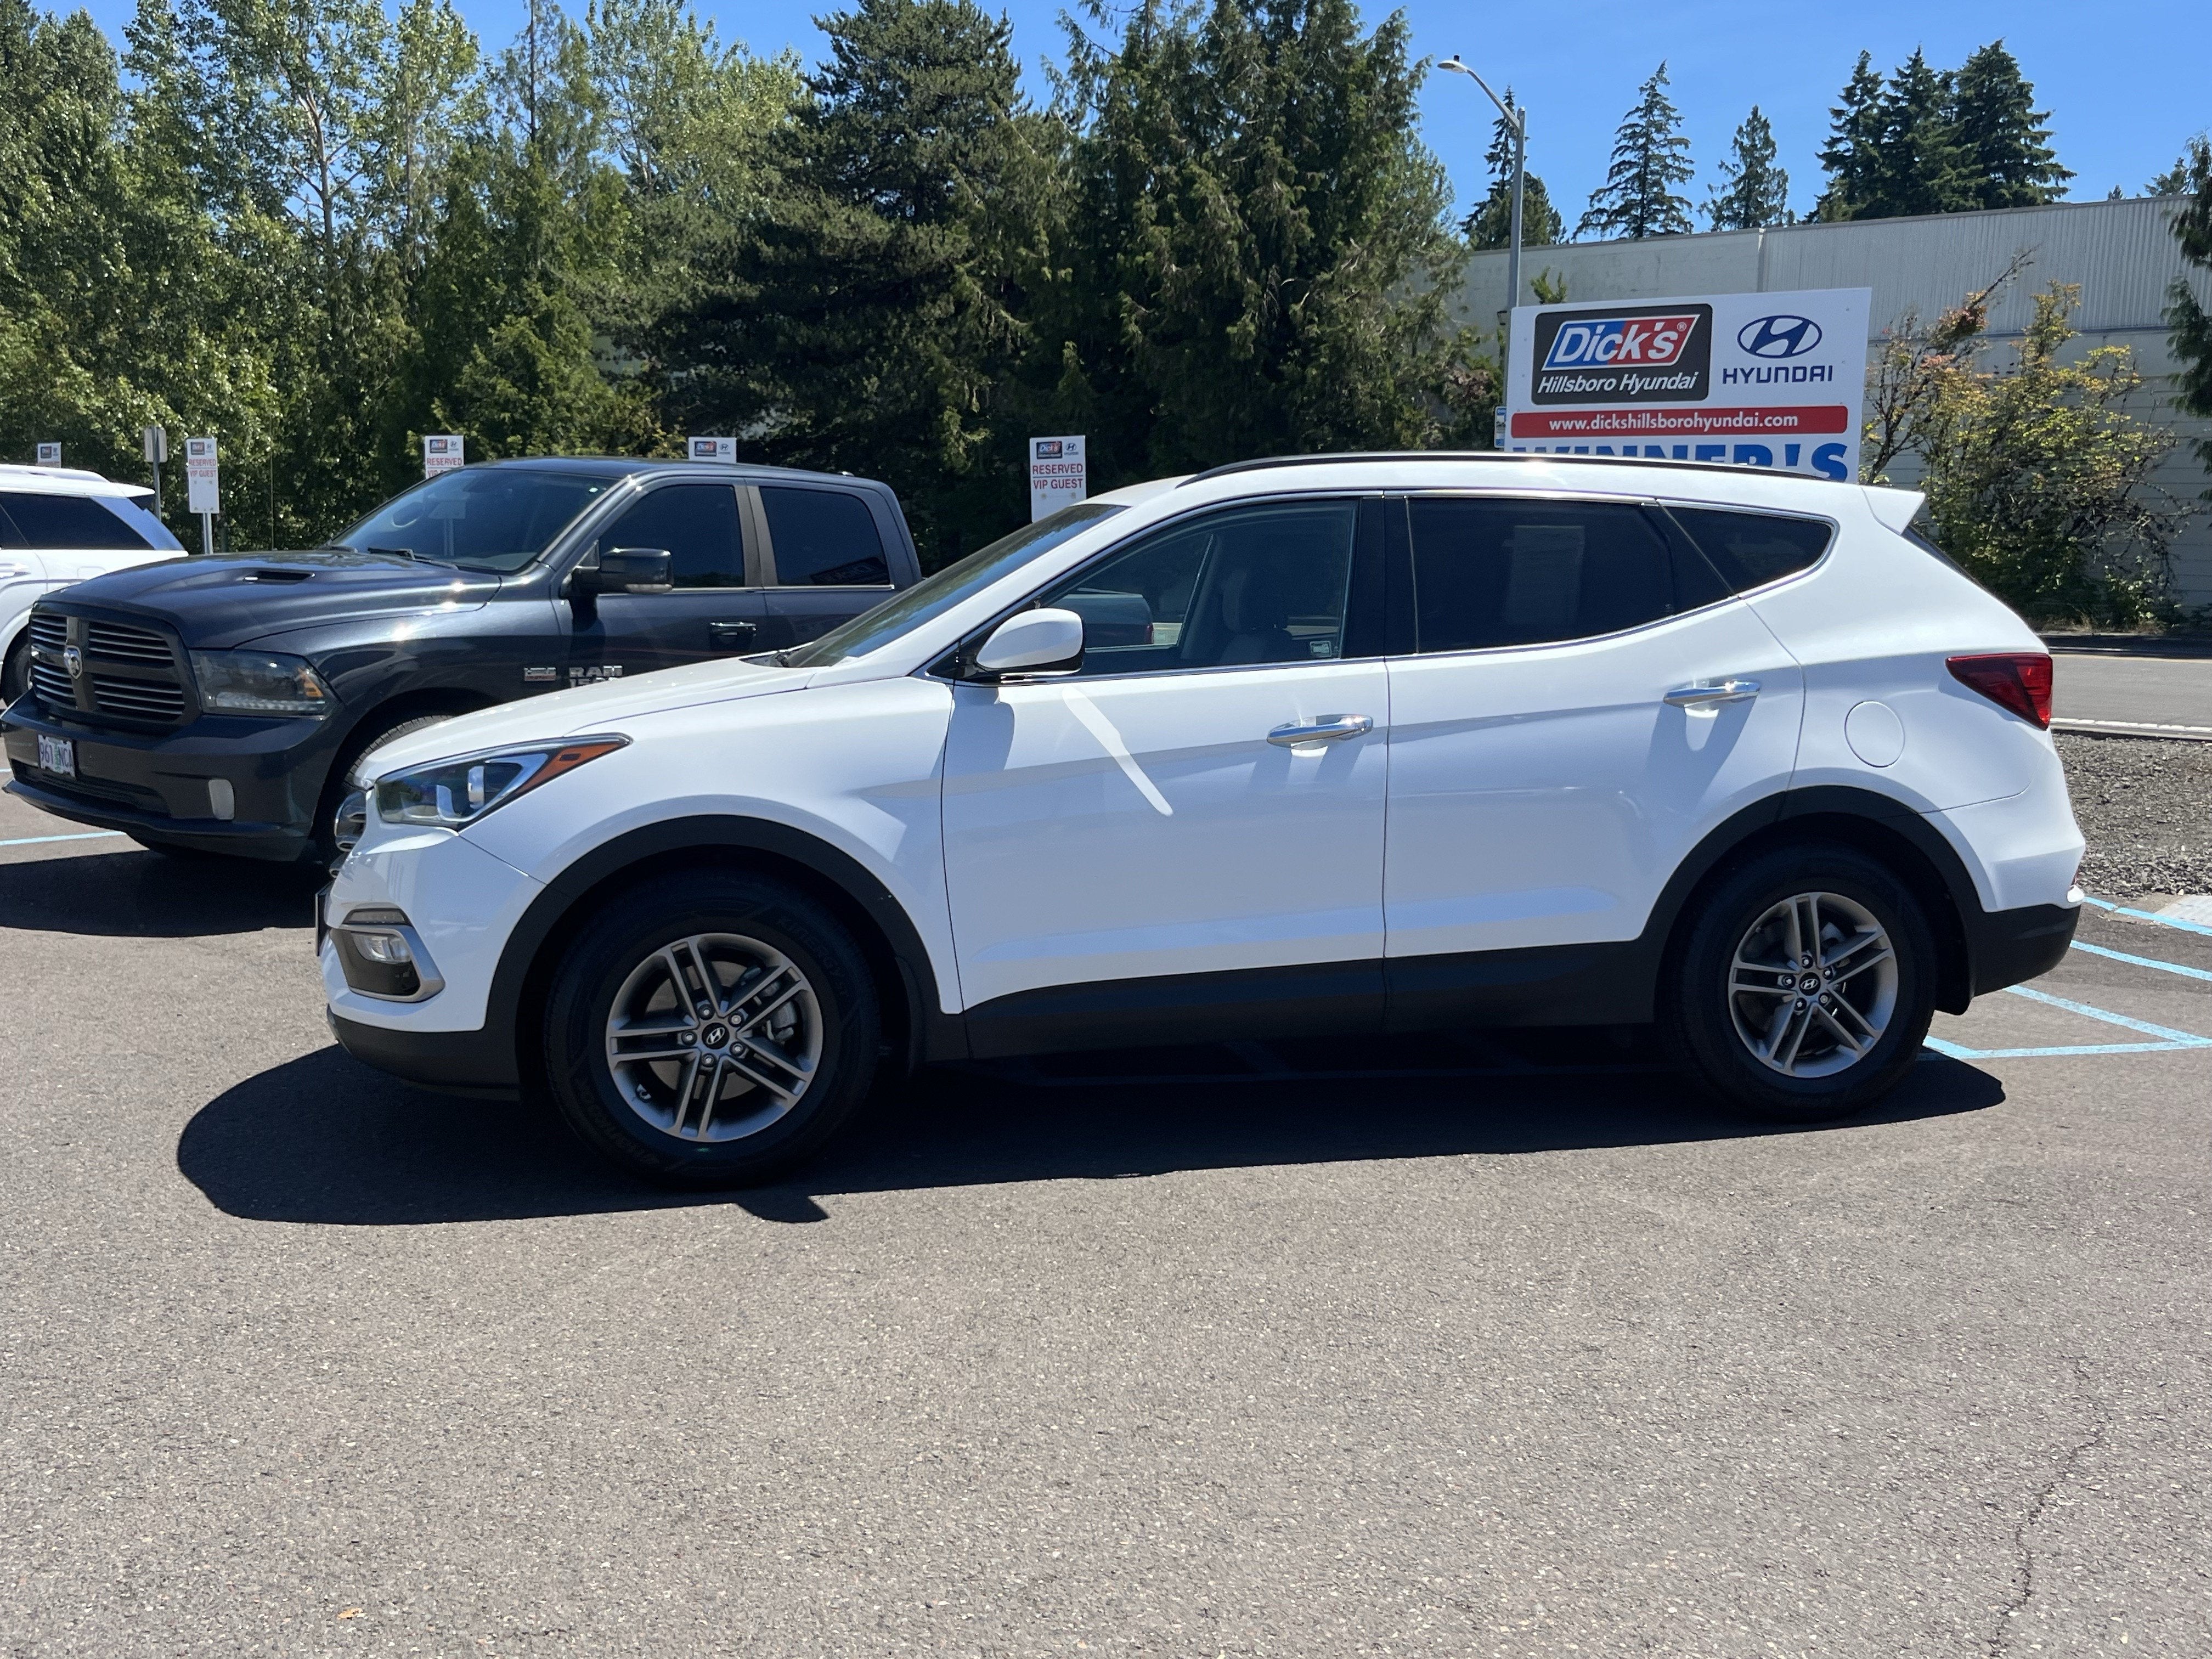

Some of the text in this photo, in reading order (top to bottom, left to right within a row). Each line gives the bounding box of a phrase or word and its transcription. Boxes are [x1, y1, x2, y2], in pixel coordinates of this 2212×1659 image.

[1553, 322, 1678, 363] Dick's
[1537, 371, 1700, 395] Hillsboro Hyundai
[1722, 365, 1833, 385] HYUNDAI
[1549, 412, 1798, 432] www.dickshillsborohyundai.com
[427, 458, 462, 466] RESERVED
[1032, 464, 1084, 475] RESERVED
[1033, 478, 1084, 489] VIP GUEST
[569, 665, 623, 678] RAM
